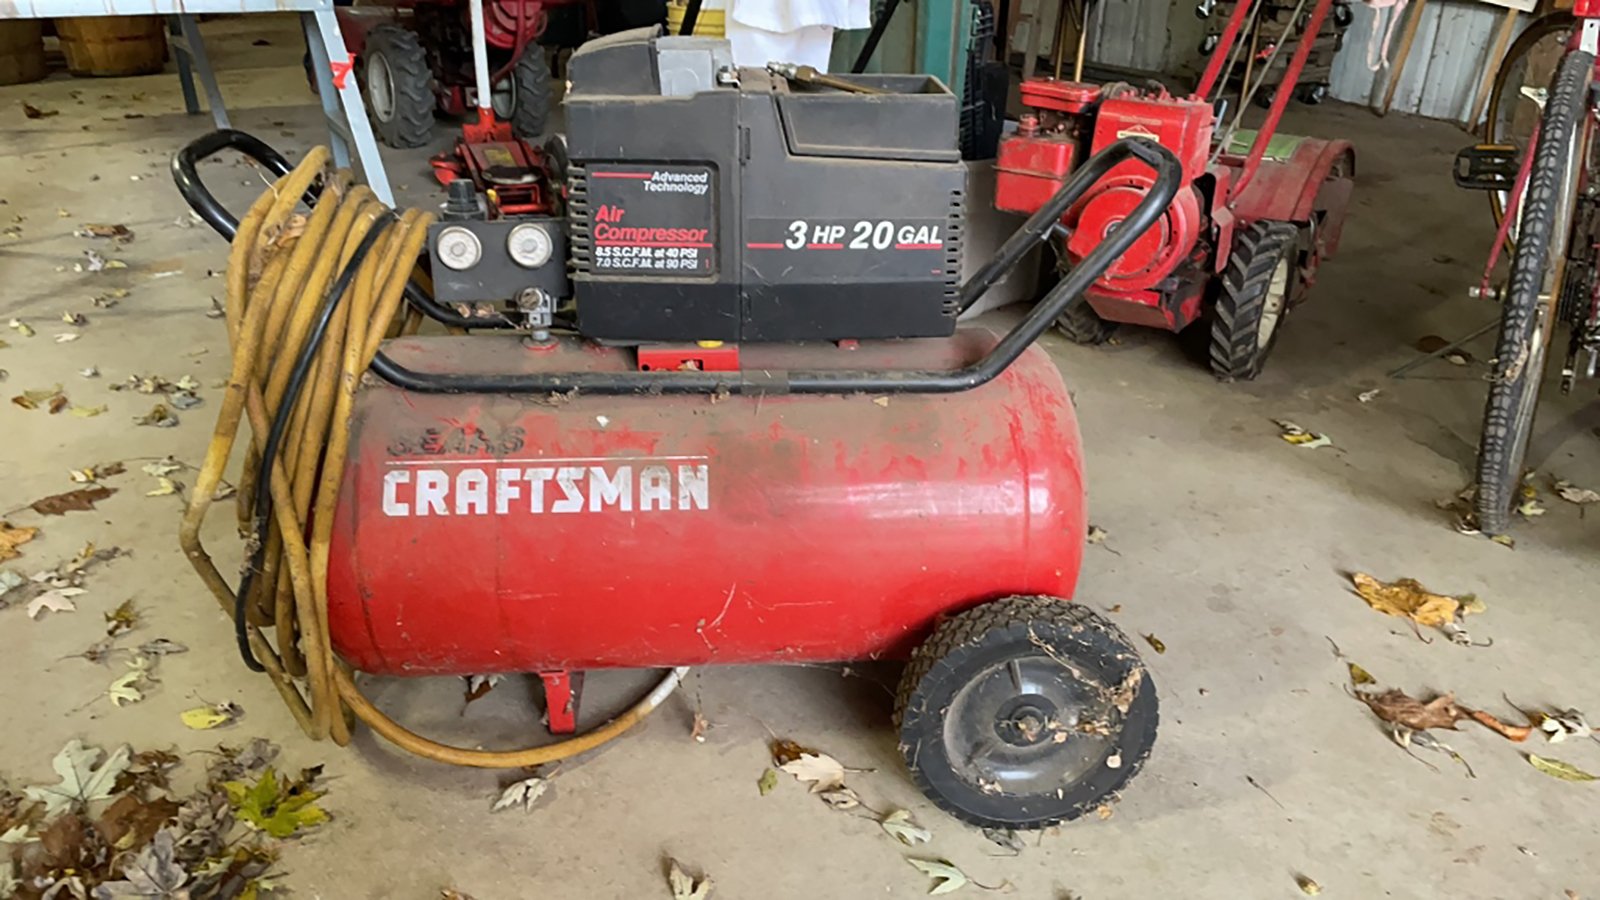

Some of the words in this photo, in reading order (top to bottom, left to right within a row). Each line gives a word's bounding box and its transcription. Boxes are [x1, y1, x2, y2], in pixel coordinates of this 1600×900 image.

[651, 171, 708, 182] Advanced
[643, 181, 708, 195] Technology
[595, 204, 625, 222] Air
[594, 223, 708, 242] Compressor
[785, 220, 808, 250] 3
[812, 225, 846, 244] HP
[849, 221, 894, 250] 20
[897, 226, 943, 245] GAL
[595, 247, 611, 257] 8.5
[654, 249, 665, 258] at
[666, 248, 679, 258] 40
[680, 248, 698, 259] PSI
[596, 258, 611, 267] 7.0
[654, 259, 665, 269] at
[666, 259, 679, 269] 90
[680, 259, 698, 269] PSI
[382, 465, 709, 517] CRAFTSMAN
